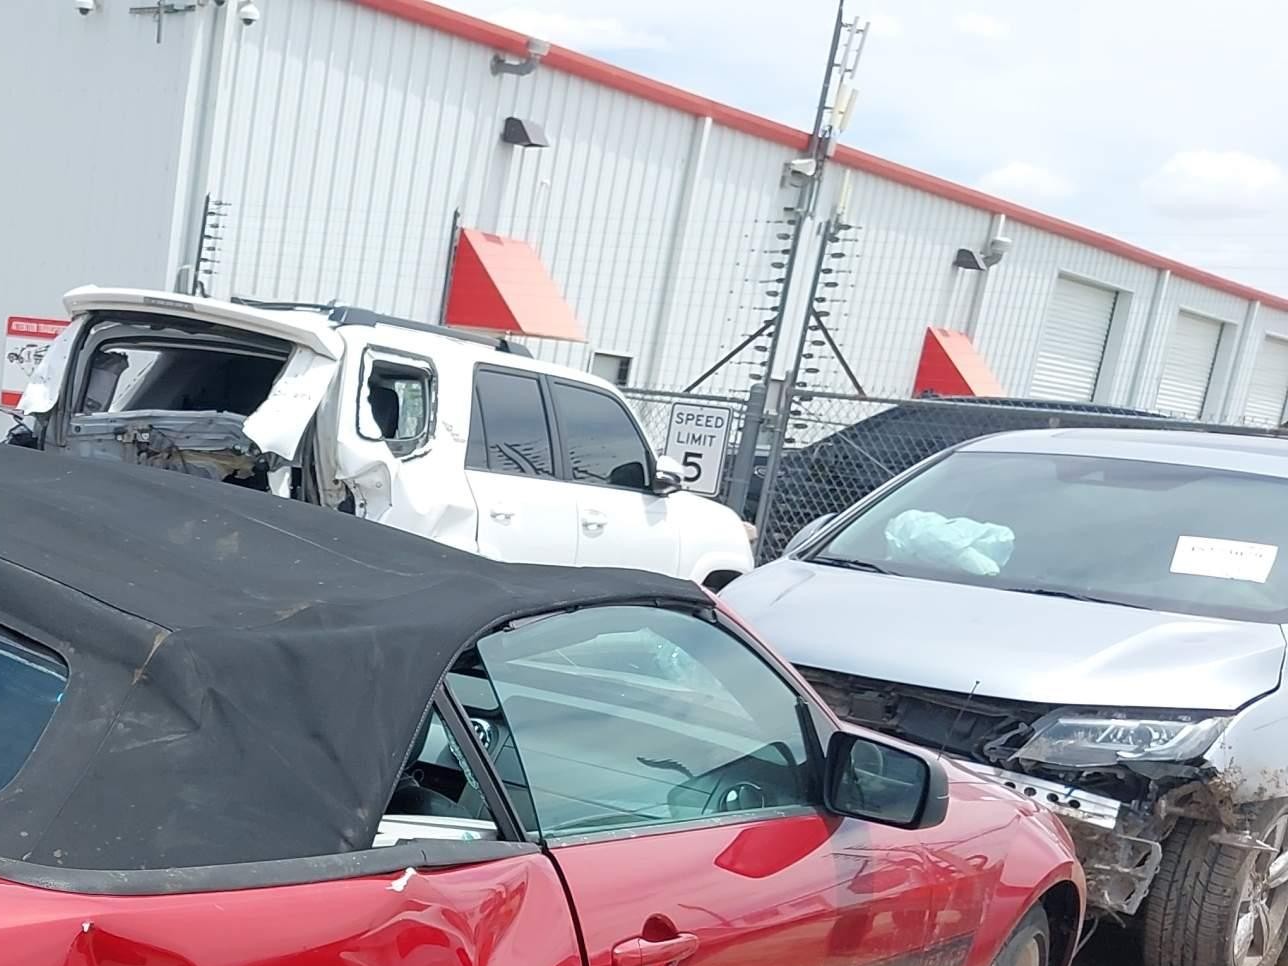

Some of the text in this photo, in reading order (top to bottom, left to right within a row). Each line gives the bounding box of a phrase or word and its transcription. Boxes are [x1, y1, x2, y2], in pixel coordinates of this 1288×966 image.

[675, 412, 724, 429] SPEED
[676, 431, 717, 447] LIMIT
[682, 451, 704, 483] 5
